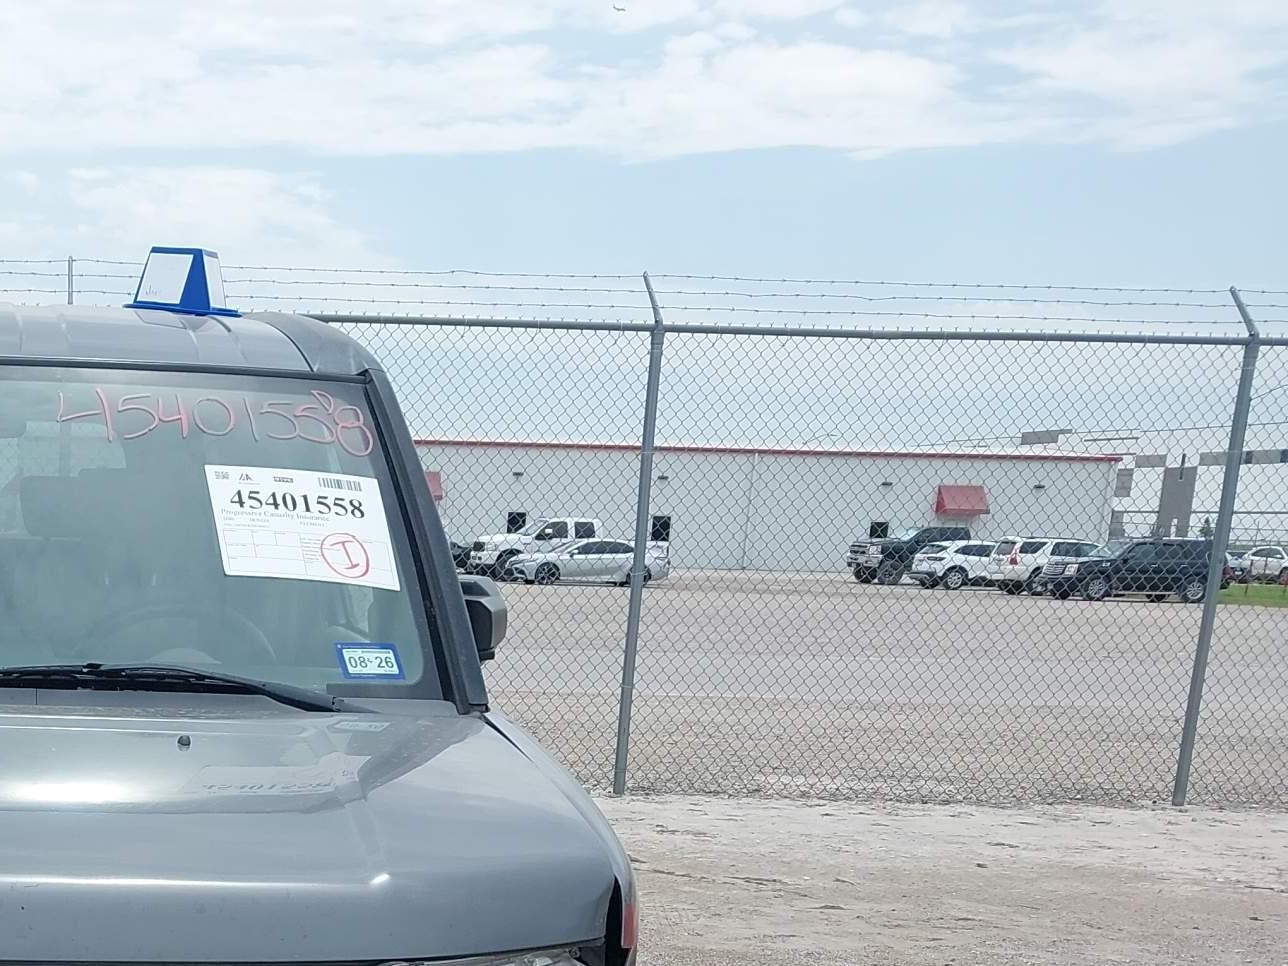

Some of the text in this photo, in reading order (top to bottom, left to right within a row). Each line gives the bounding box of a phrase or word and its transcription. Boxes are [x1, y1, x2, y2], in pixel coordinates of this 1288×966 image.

[230, 489, 365, 519] 45401558
[348, 656, 394, 669] 08 26
